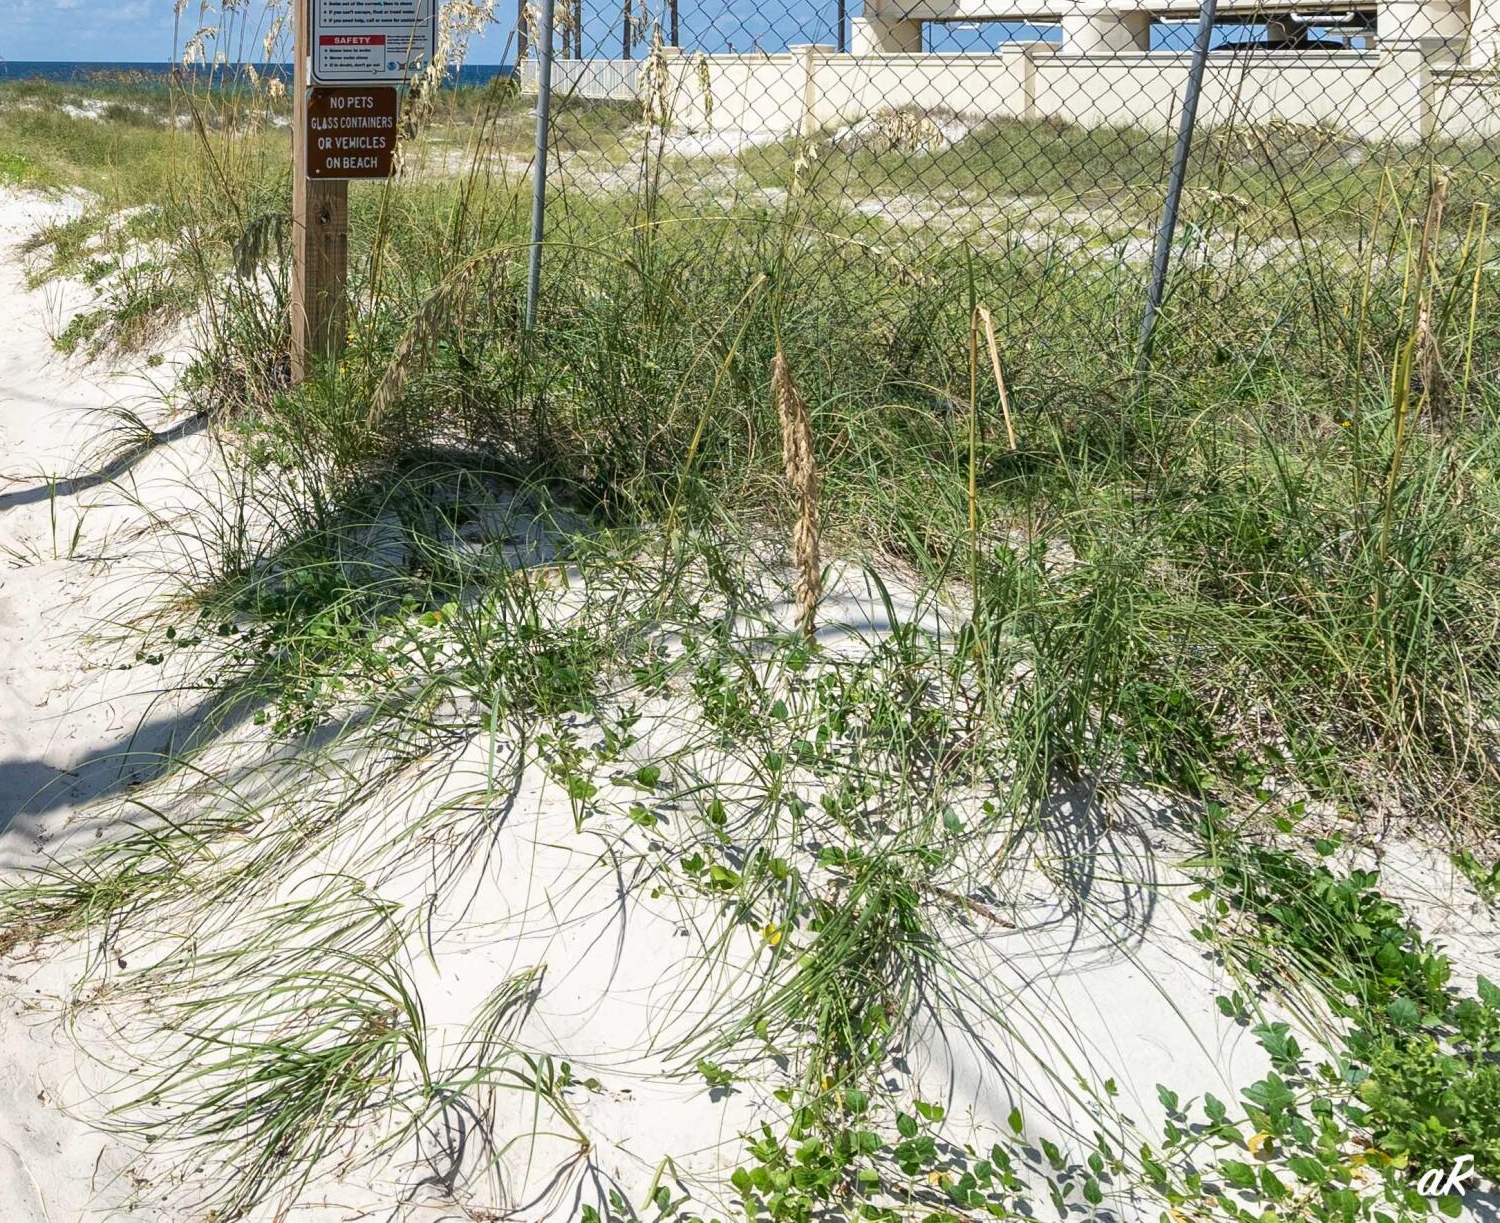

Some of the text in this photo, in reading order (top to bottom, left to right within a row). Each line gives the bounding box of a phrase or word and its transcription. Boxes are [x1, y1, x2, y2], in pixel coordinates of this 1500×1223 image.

[334, 36, 371, 44] SAFETY
[330, 96, 374, 109] NO PETS
[311, 116, 393, 131] GLASS CONTAINERS
[317, 136, 386, 150] OR VEHICLES
[325, 156, 378, 169] ON BEACH
